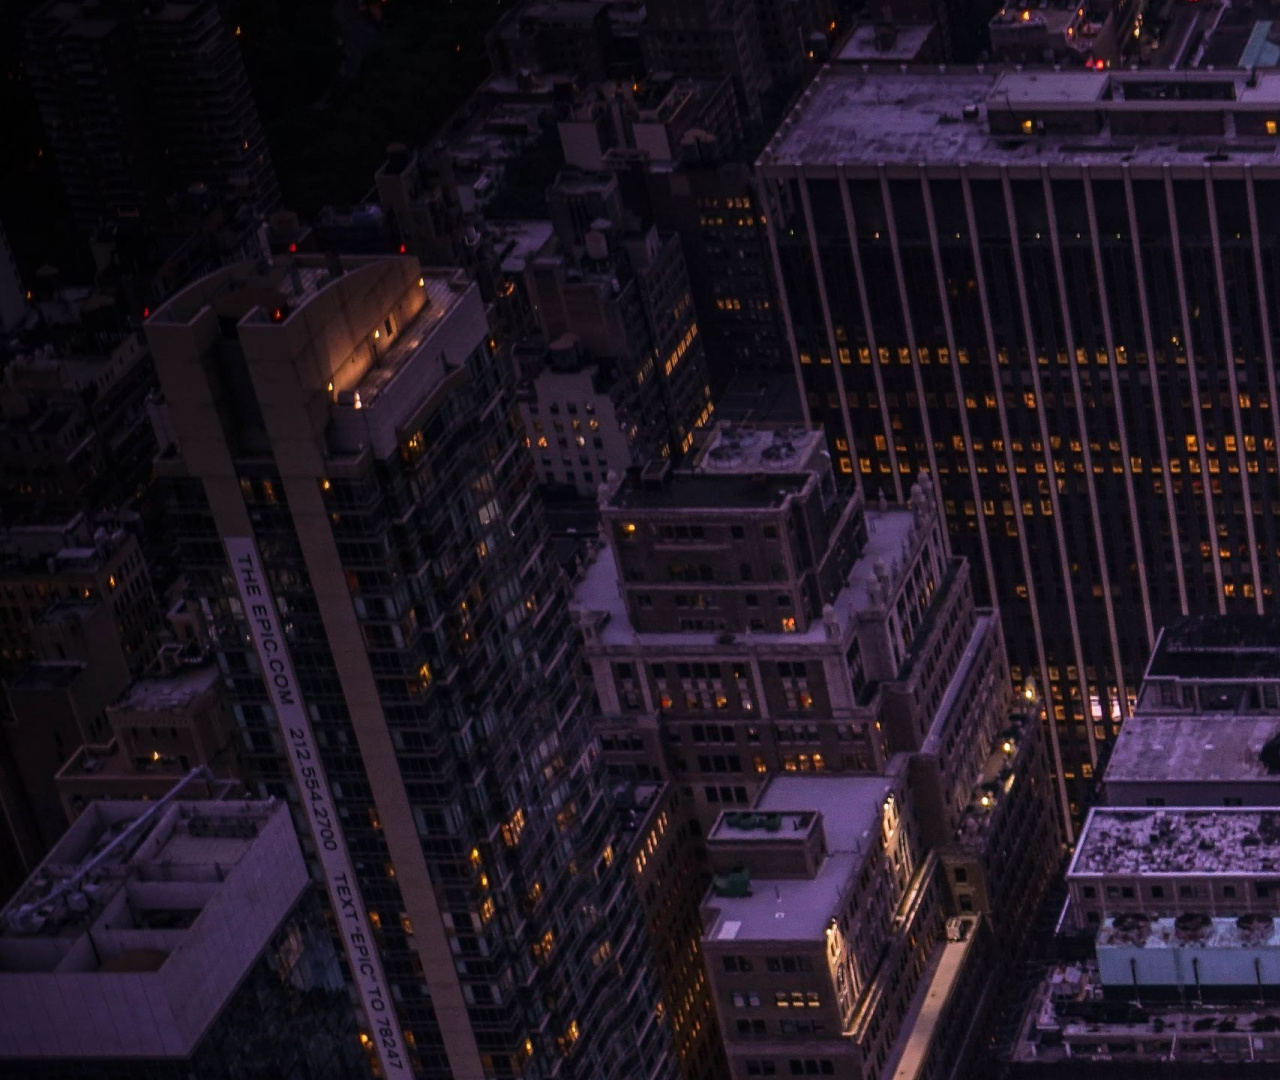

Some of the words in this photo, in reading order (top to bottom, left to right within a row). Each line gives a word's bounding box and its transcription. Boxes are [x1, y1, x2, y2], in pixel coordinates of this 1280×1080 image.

[237, 553, 262, 597] THE
[251, 604, 295, 706] EPIC.COM
[333, 871, 359, 922] TEXT
[367, 986, 386, 1012] TO
[375, 1018, 404, 1071] 78247
